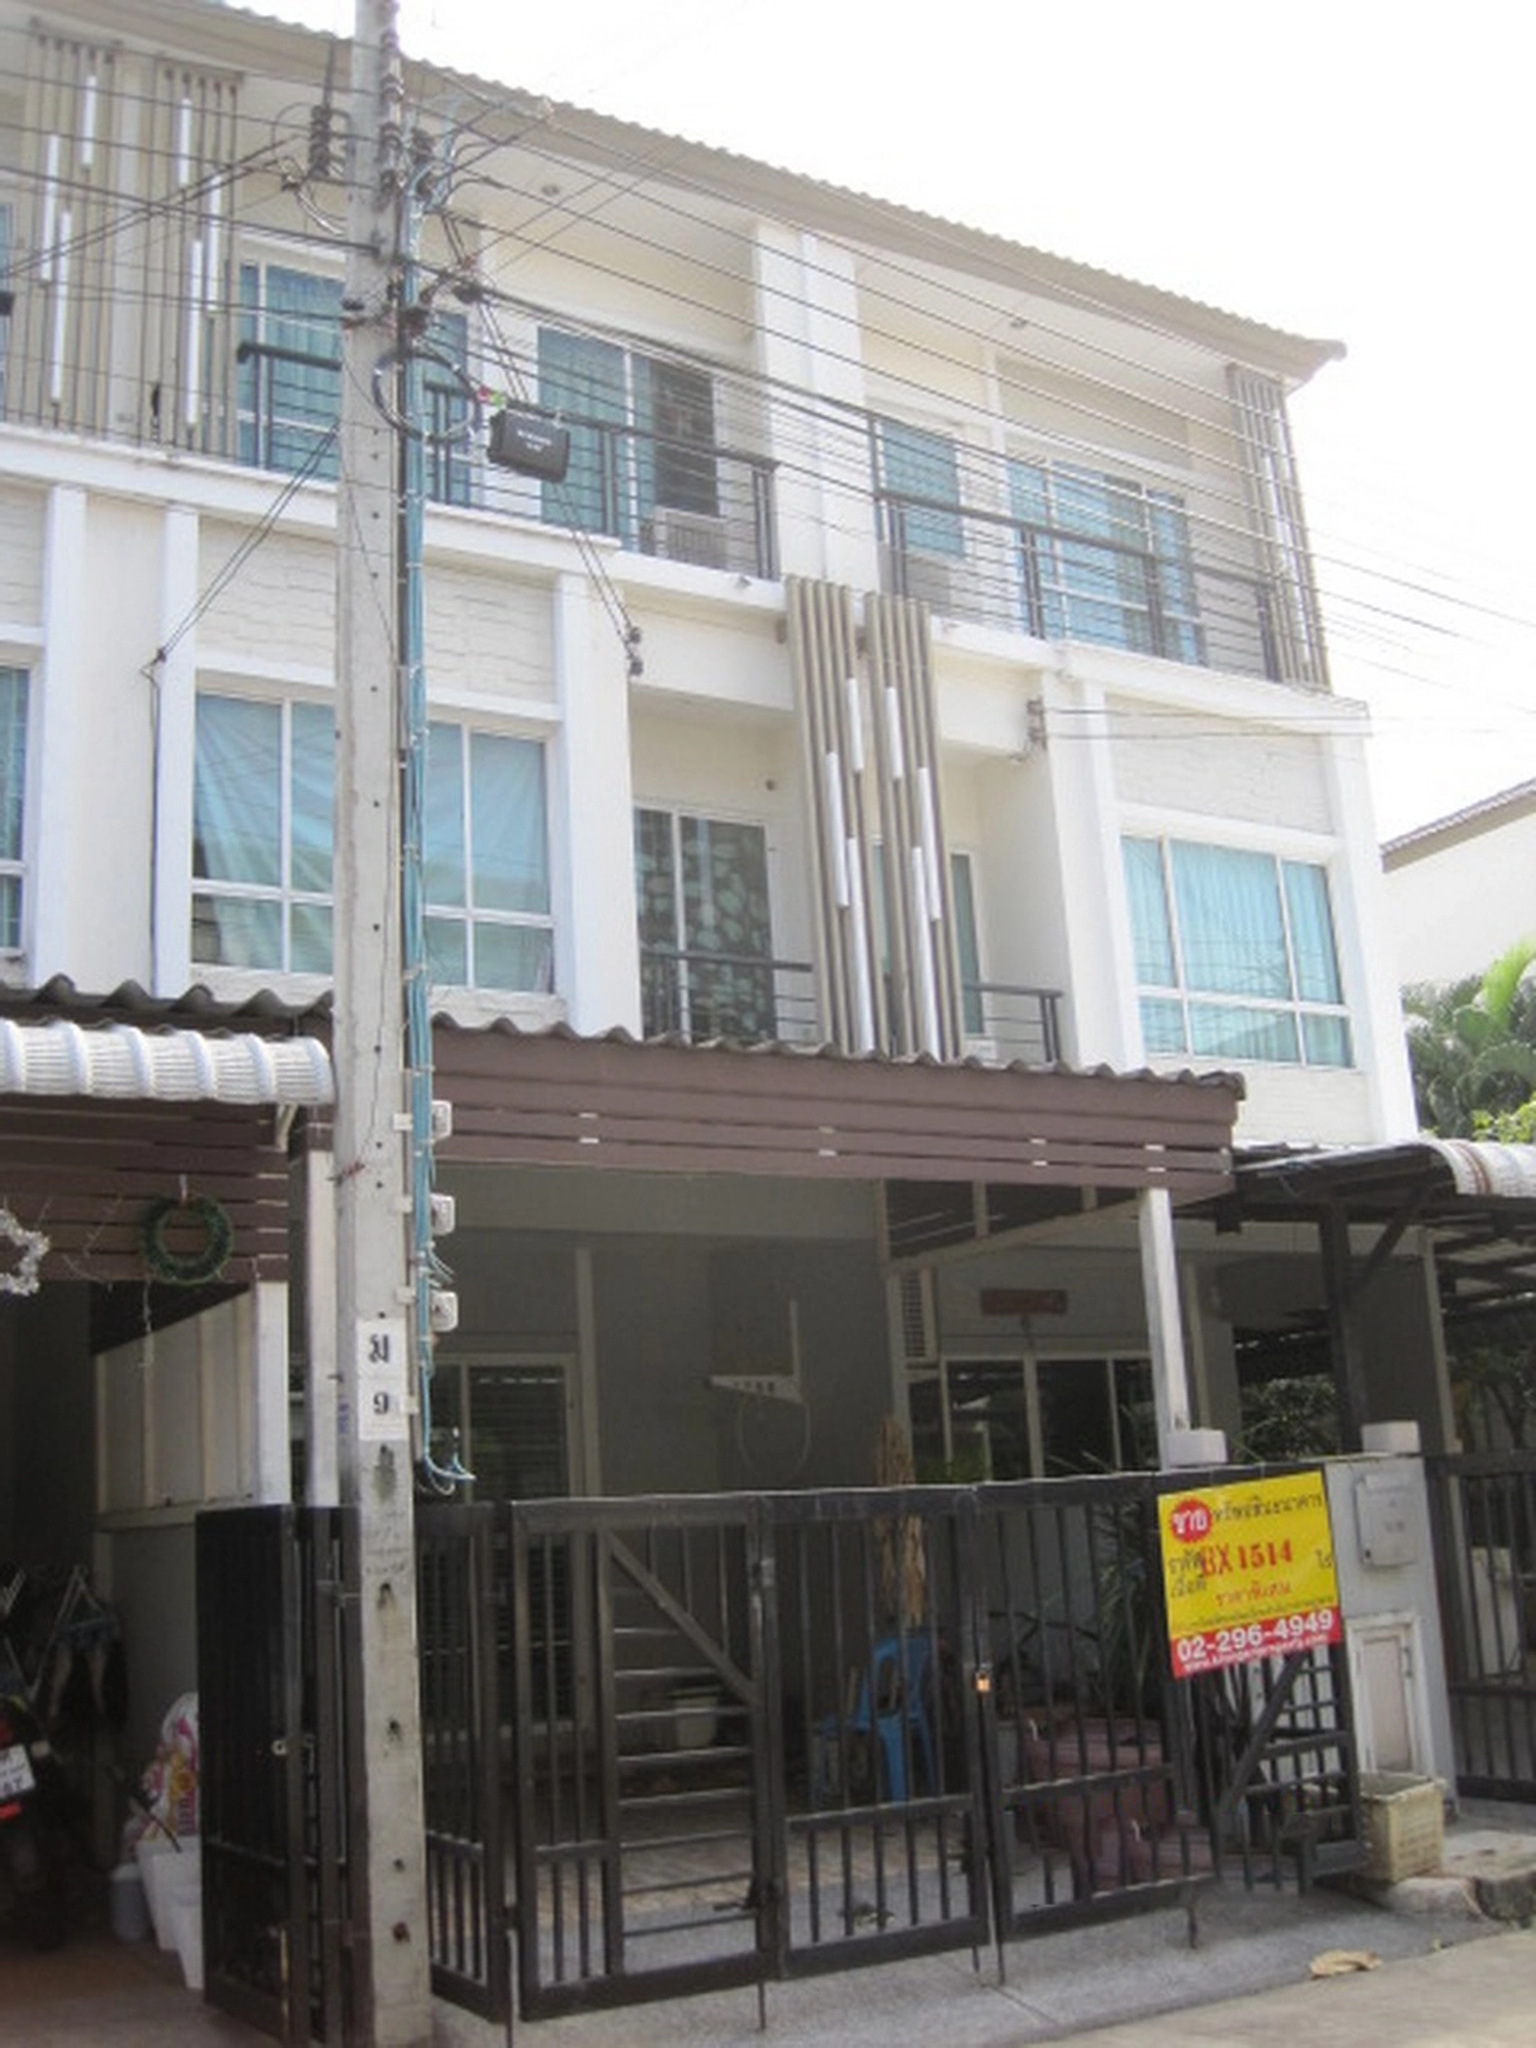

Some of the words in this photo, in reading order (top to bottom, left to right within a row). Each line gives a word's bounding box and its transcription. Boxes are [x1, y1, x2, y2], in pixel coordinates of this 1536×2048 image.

[1172, 1509, 1208, 1535] ขาย
[1238, 1539, 1292, 1570] 1514
[1177, 1609, 1333, 1661] 02-296-4949
